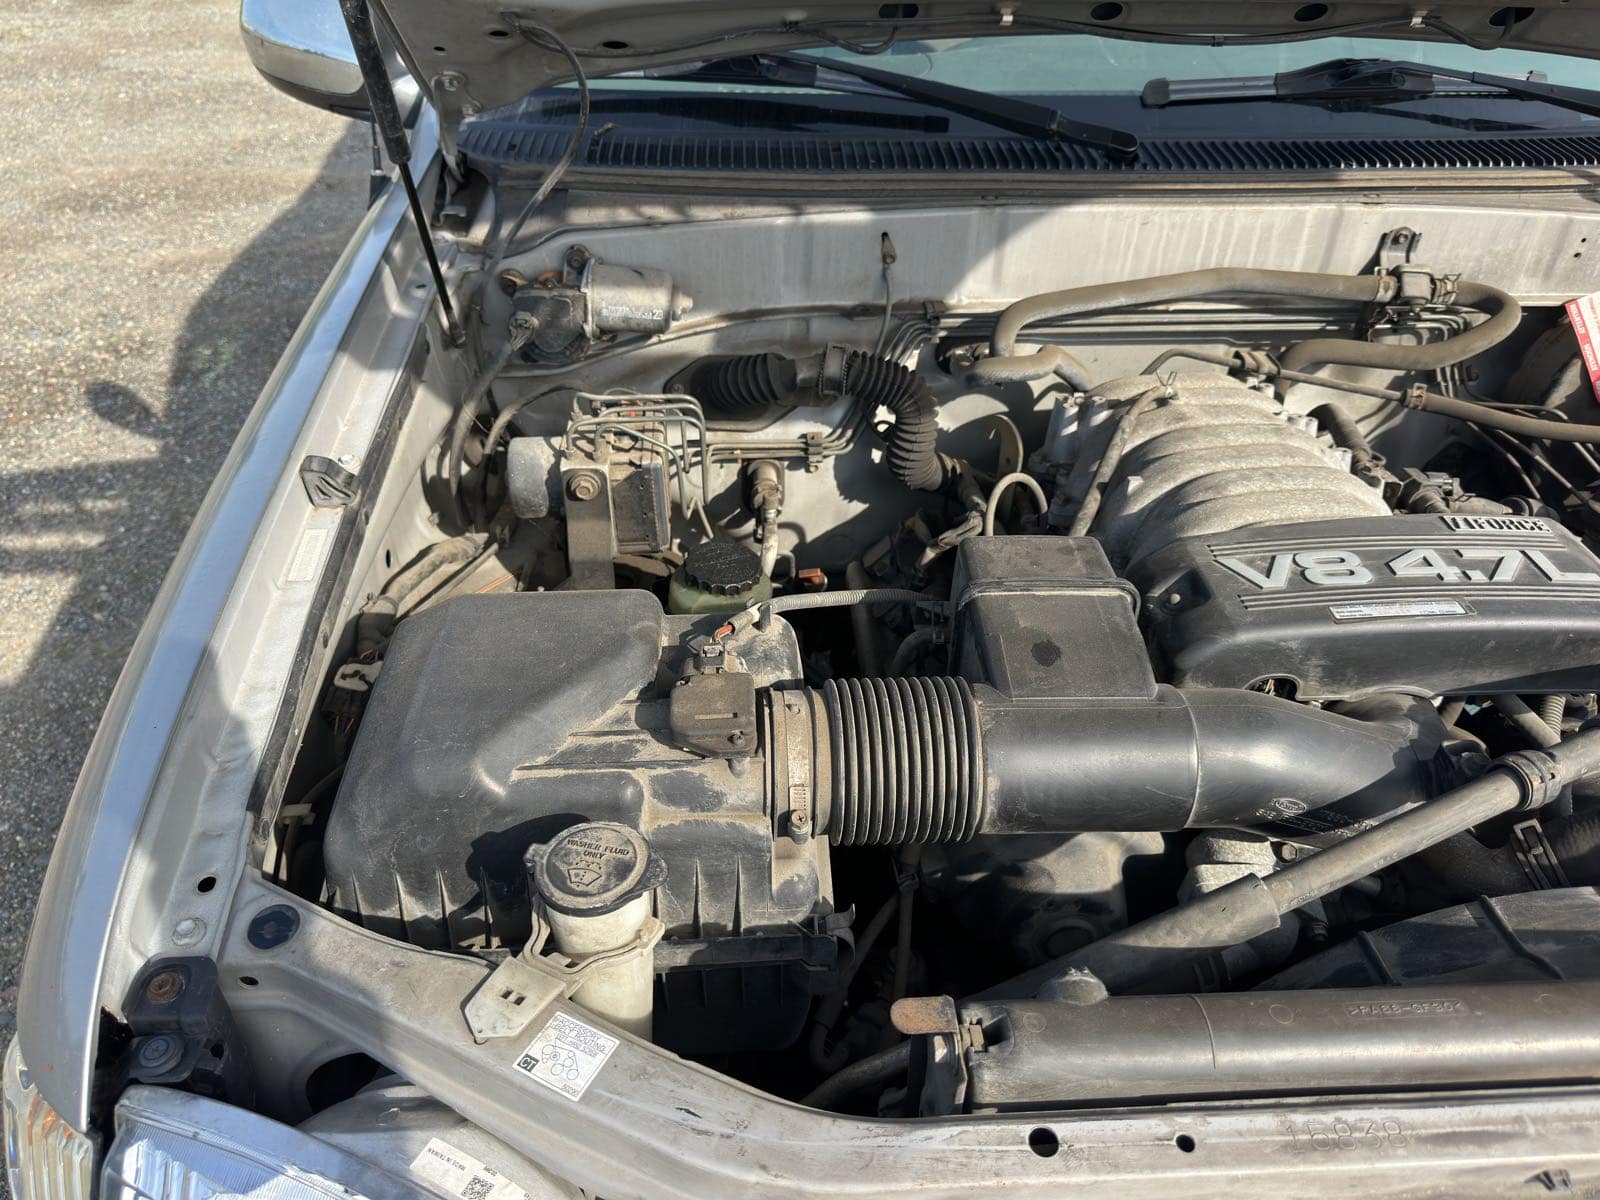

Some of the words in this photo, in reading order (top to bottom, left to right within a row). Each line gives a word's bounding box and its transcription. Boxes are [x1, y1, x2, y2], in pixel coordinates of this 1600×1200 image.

[1213, 550, 1373, 590] V8
[1385, 548, 1600, 583] 4.7L
[567, 839, 602, 851] WASHER
[604, 845, 630, 856] FLUID
[583, 849, 606, 859] ONLY
[574, 1032, 606, 1052] ROUTING
[519, 1056, 536, 1070] CT
